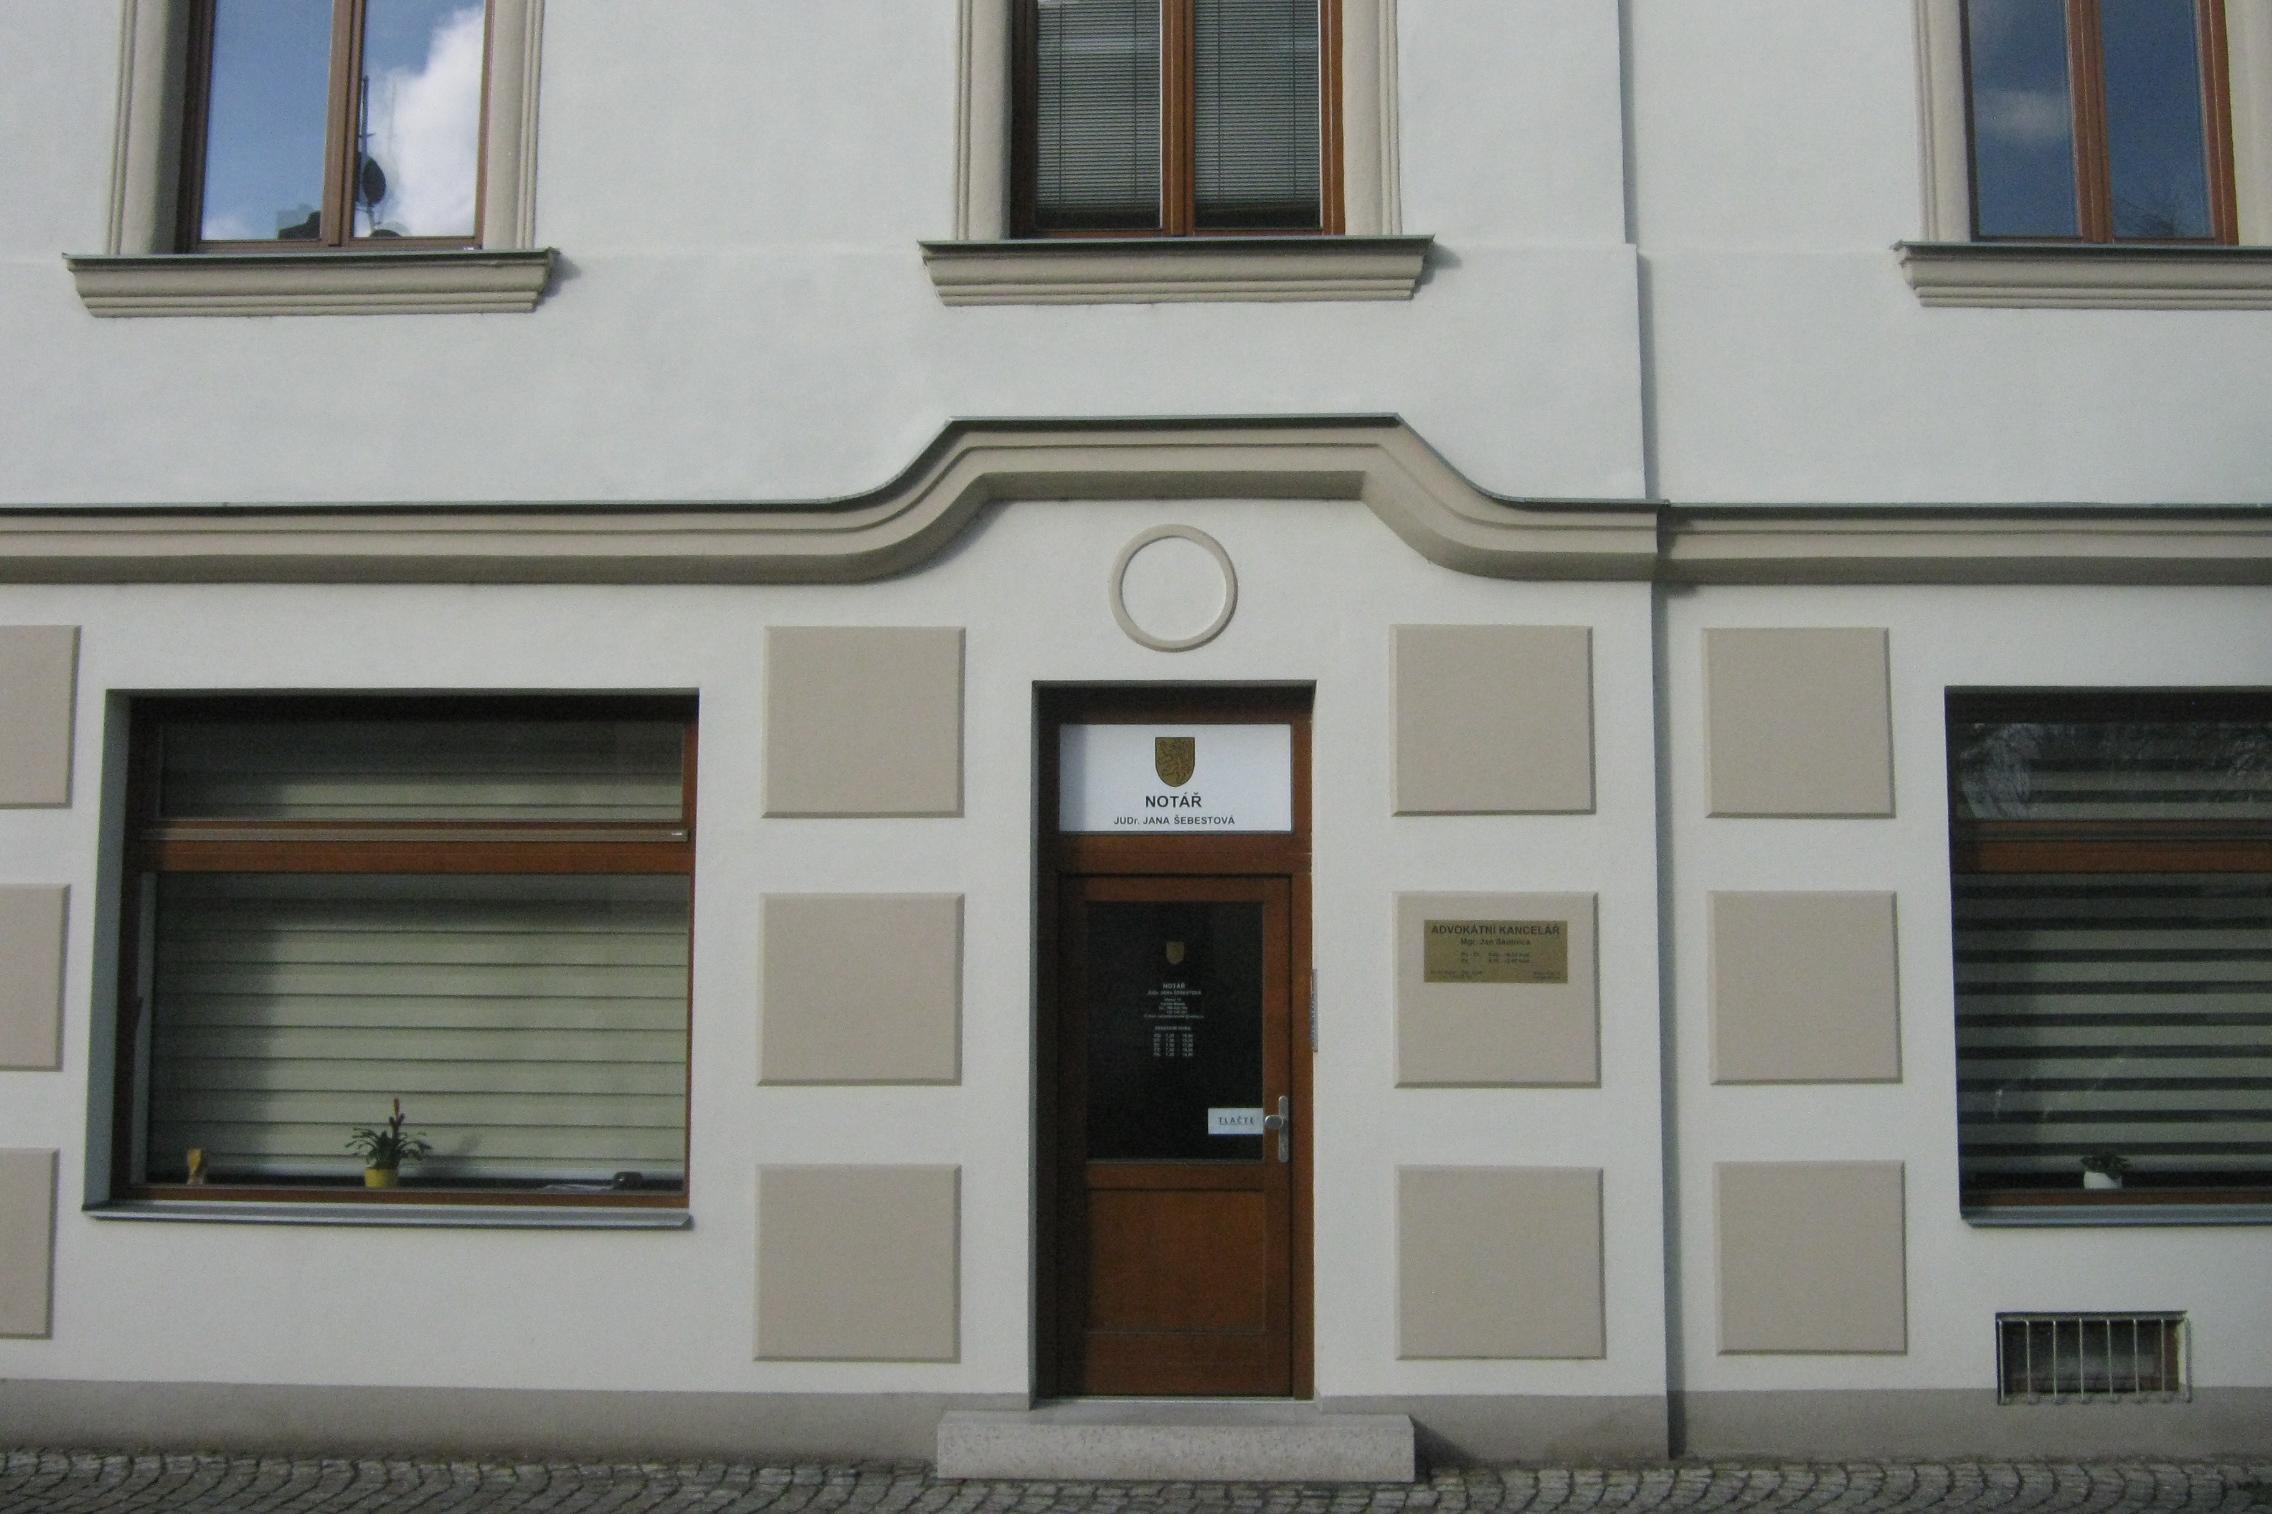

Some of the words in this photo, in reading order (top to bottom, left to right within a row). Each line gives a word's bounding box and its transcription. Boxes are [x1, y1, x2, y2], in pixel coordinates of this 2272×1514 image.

[1145, 791, 1202, 808] NOTÁŘ
[1113, 816, 1140, 825] JUDr.
[1142, 816, 1170, 825] JANA
[1173, 814, 1236, 825] ŠEBESTOVÁ
